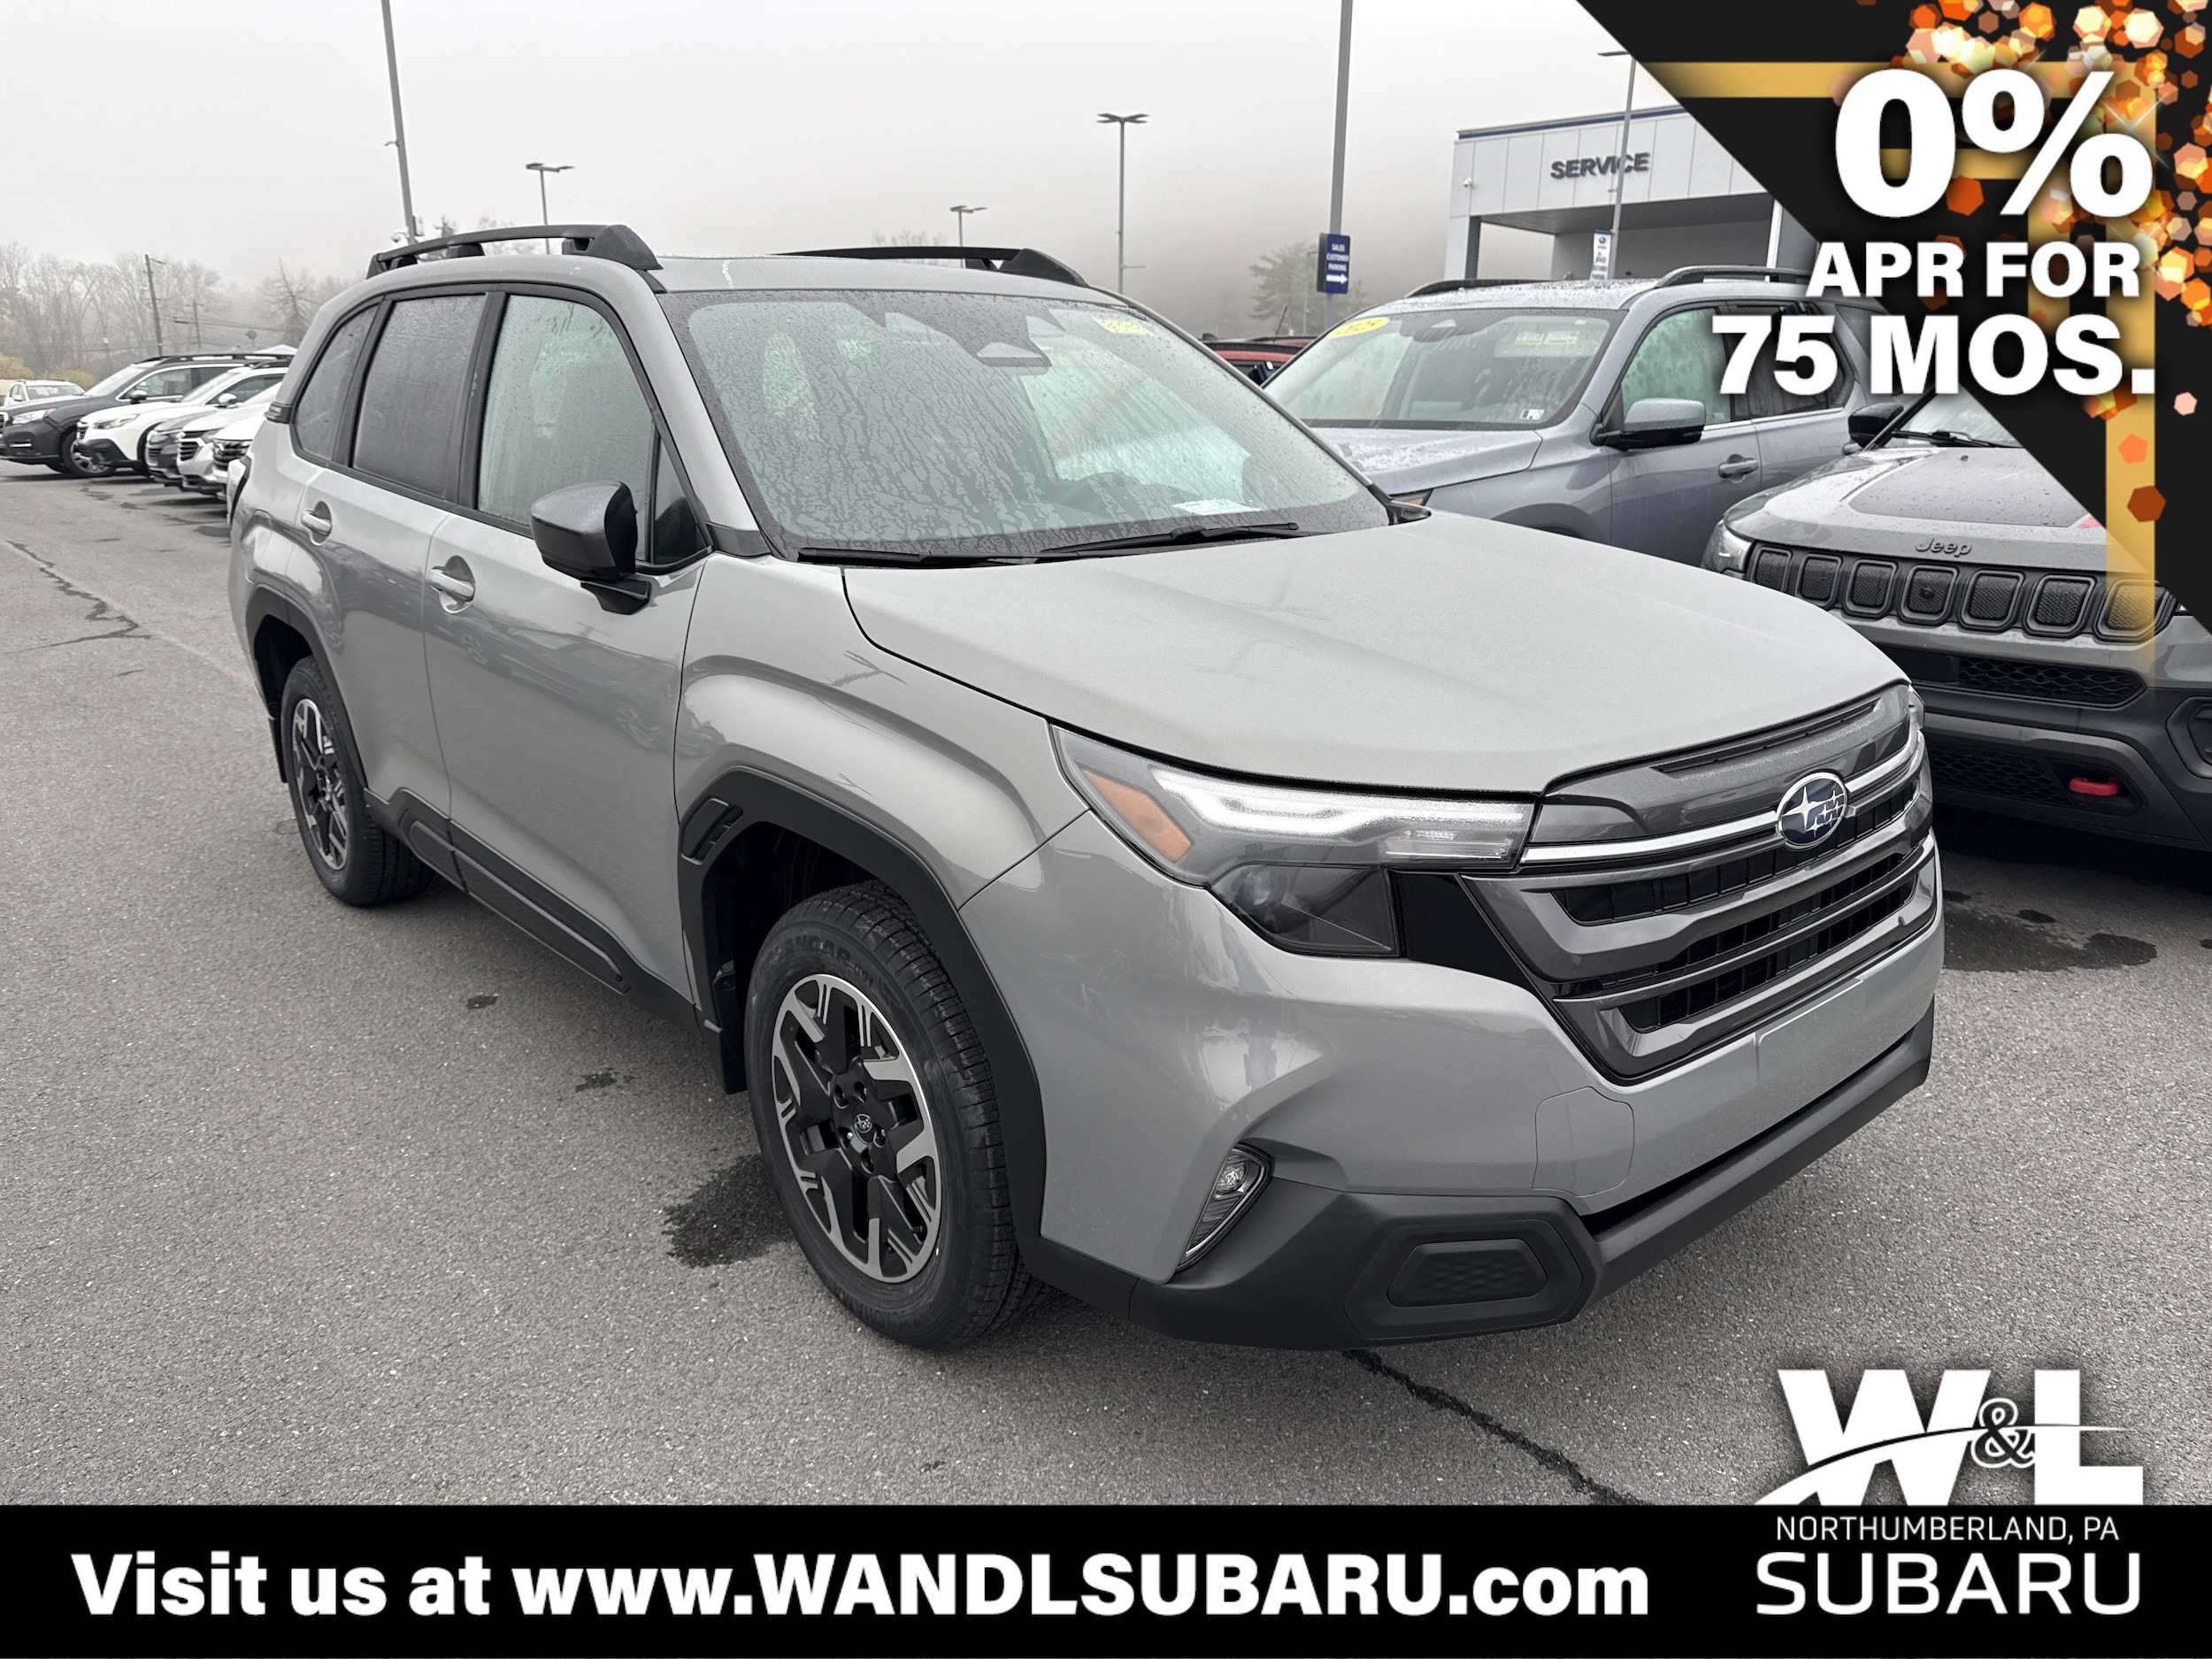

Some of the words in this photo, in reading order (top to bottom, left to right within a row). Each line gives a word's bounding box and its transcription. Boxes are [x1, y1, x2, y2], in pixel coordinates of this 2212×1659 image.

[1550, 152, 1651, 180] SERVICE
[1332, 243, 1346, 252] SALES
[1326, 253, 1349, 262] CUSTOMER
[1328, 264, 1347, 273] PARKING
[1915, 537, 1972, 558] Jeep
